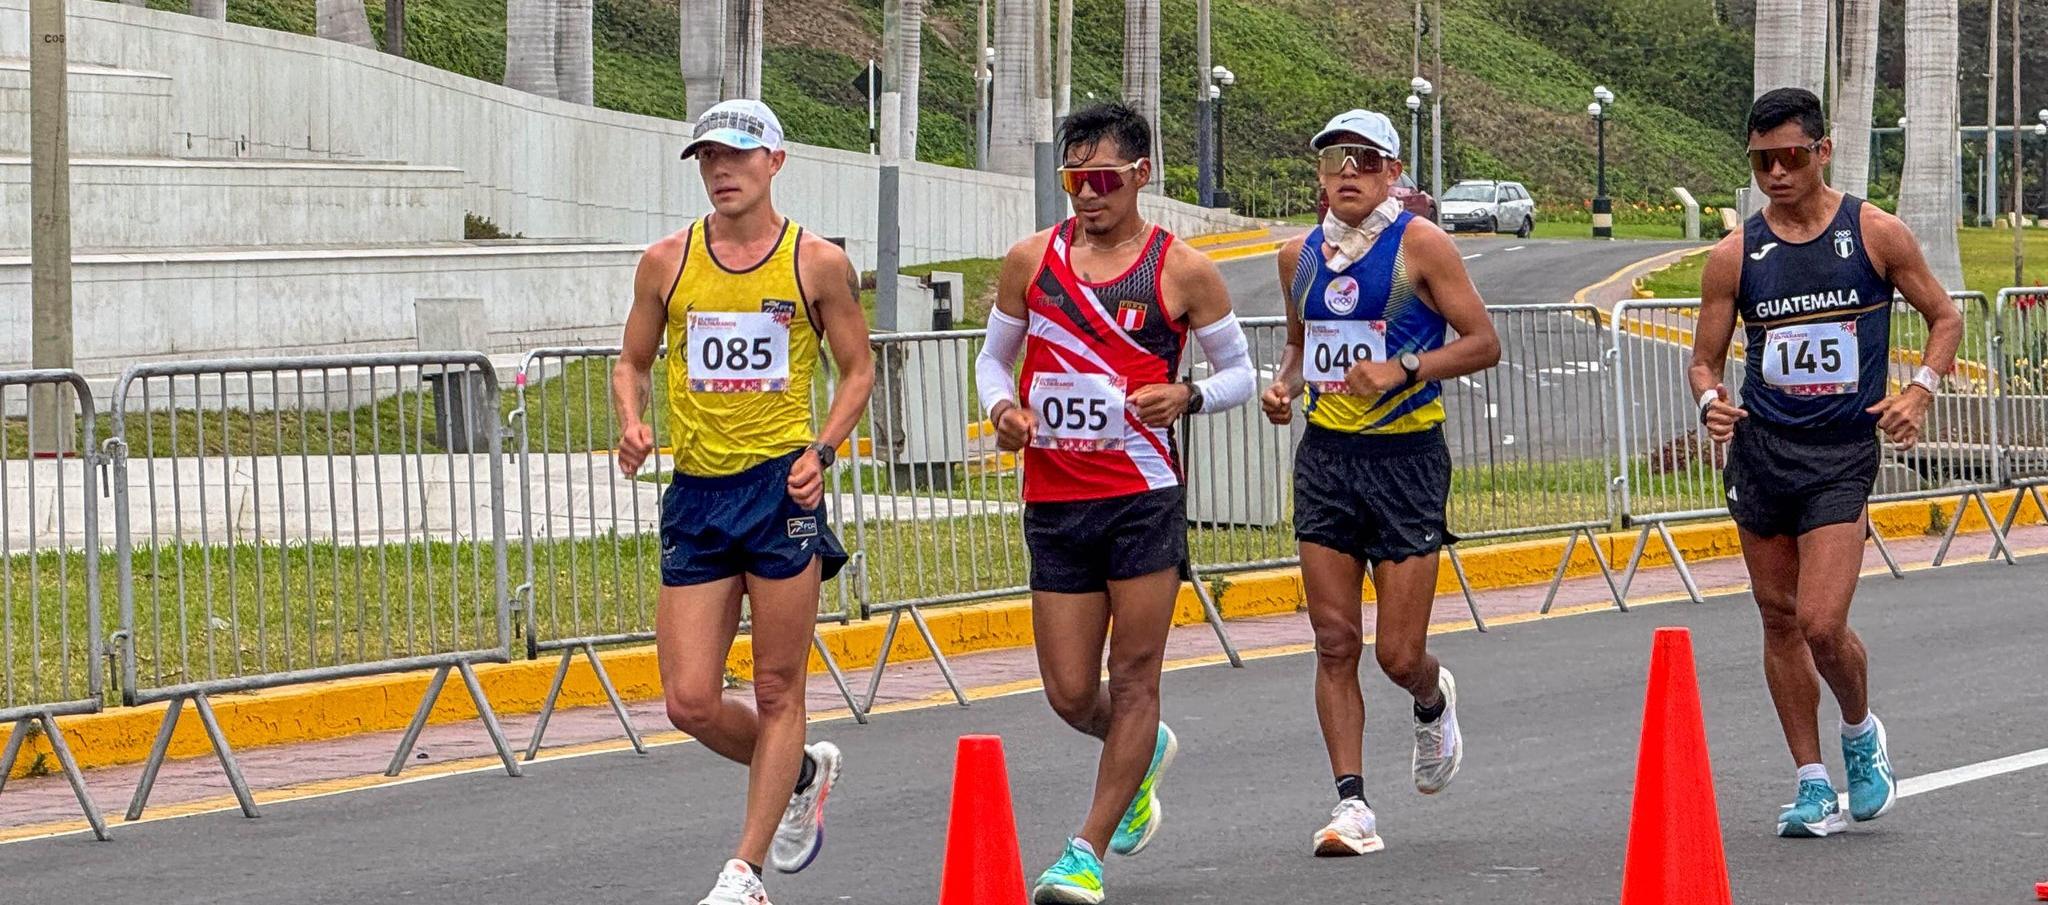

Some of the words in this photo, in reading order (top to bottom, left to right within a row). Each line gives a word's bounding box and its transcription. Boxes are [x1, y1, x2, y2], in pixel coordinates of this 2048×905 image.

[1756, 289, 1859, 318] GUATEMALA
[702, 336, 772, 371] 085
[1314, 343, 1373, 374] 049
[1777, 338, 1842, 376] 145
[1042, 396, 1108, 431] 055
